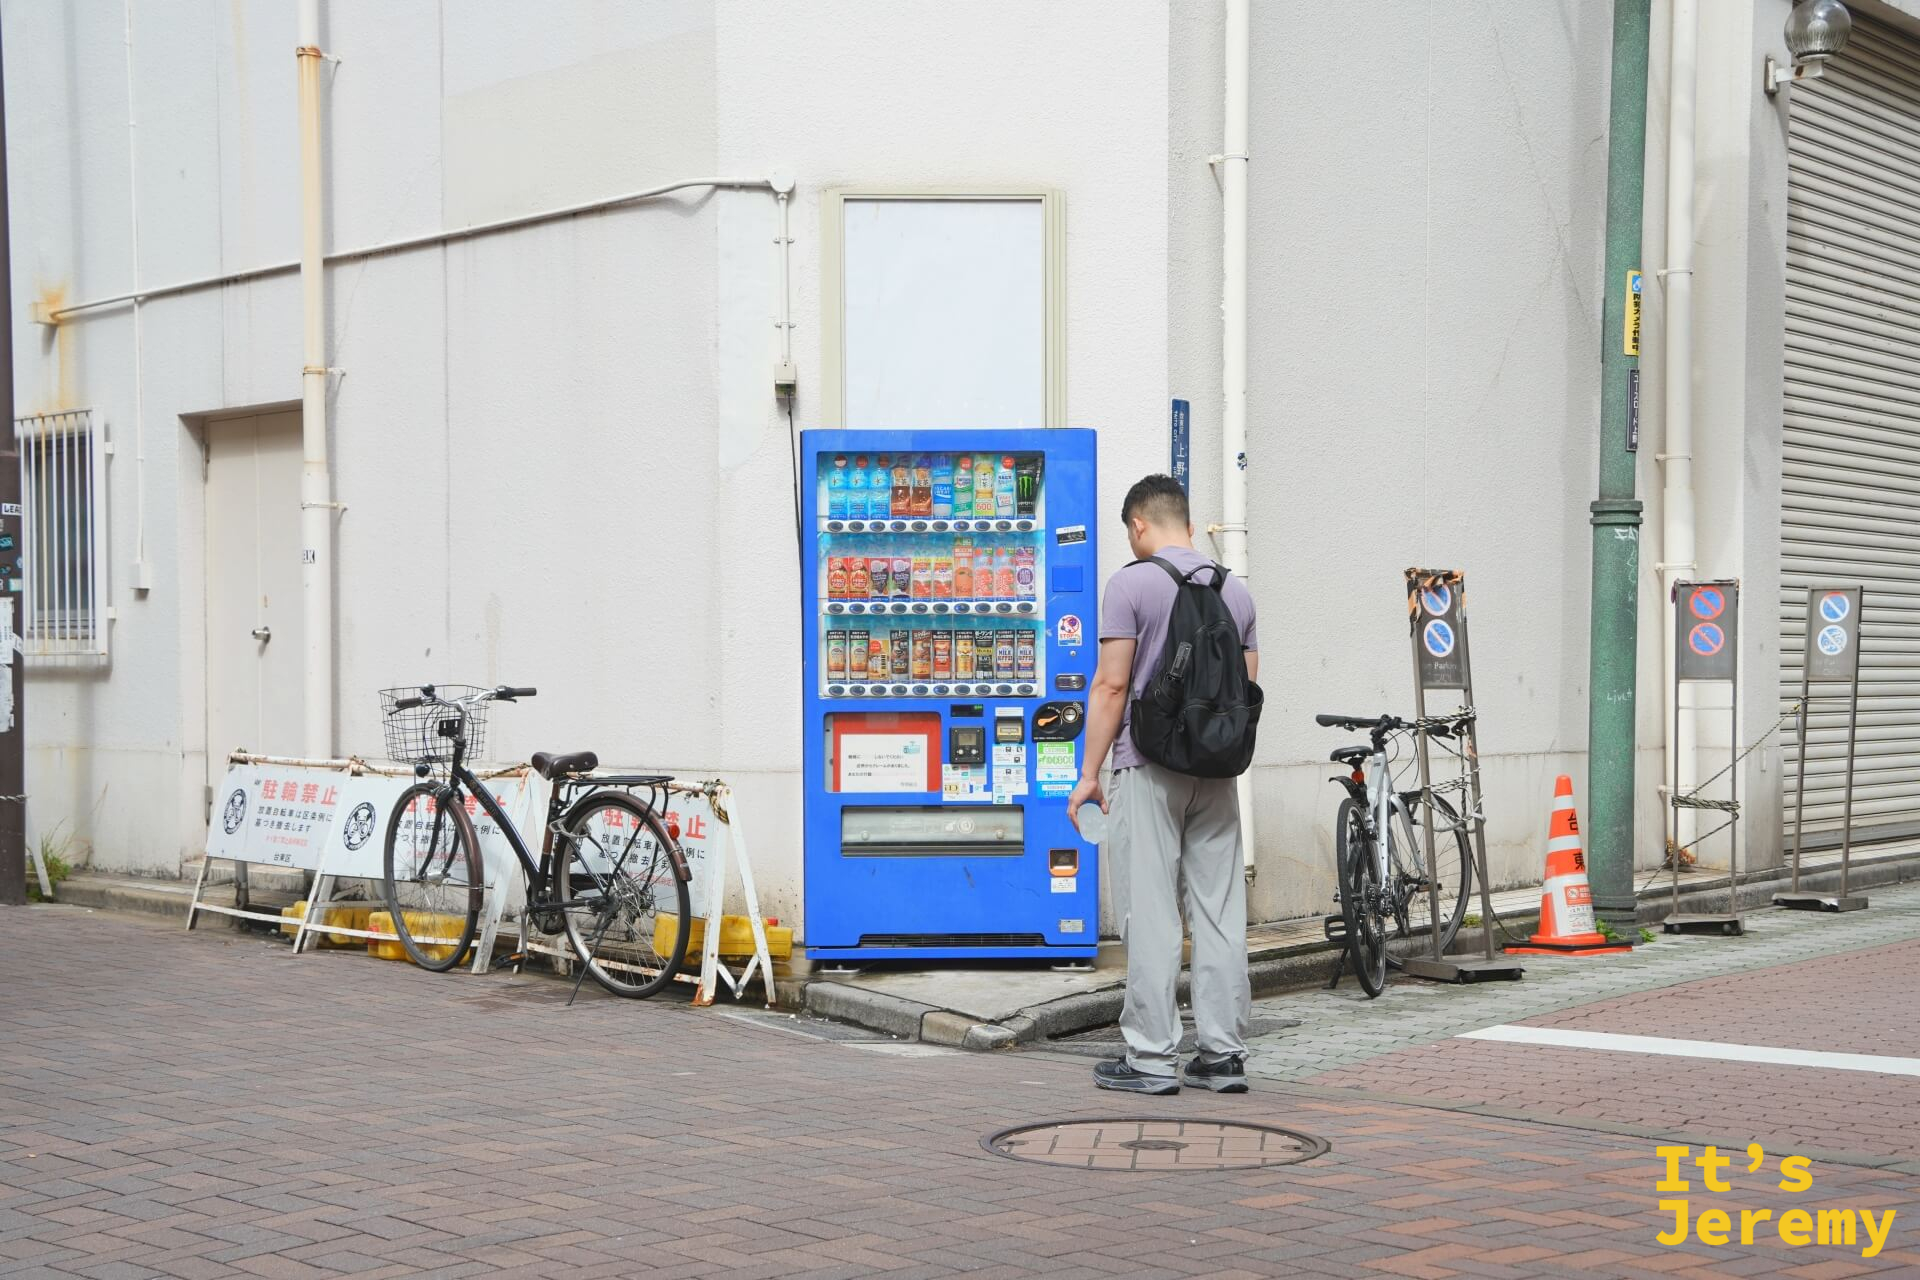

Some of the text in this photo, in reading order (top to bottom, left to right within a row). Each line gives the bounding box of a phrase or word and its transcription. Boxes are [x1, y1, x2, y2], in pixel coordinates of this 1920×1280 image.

[263, 779, 337, 805] 駐輪禁止
[273, 853, 292, 863] 台東区
